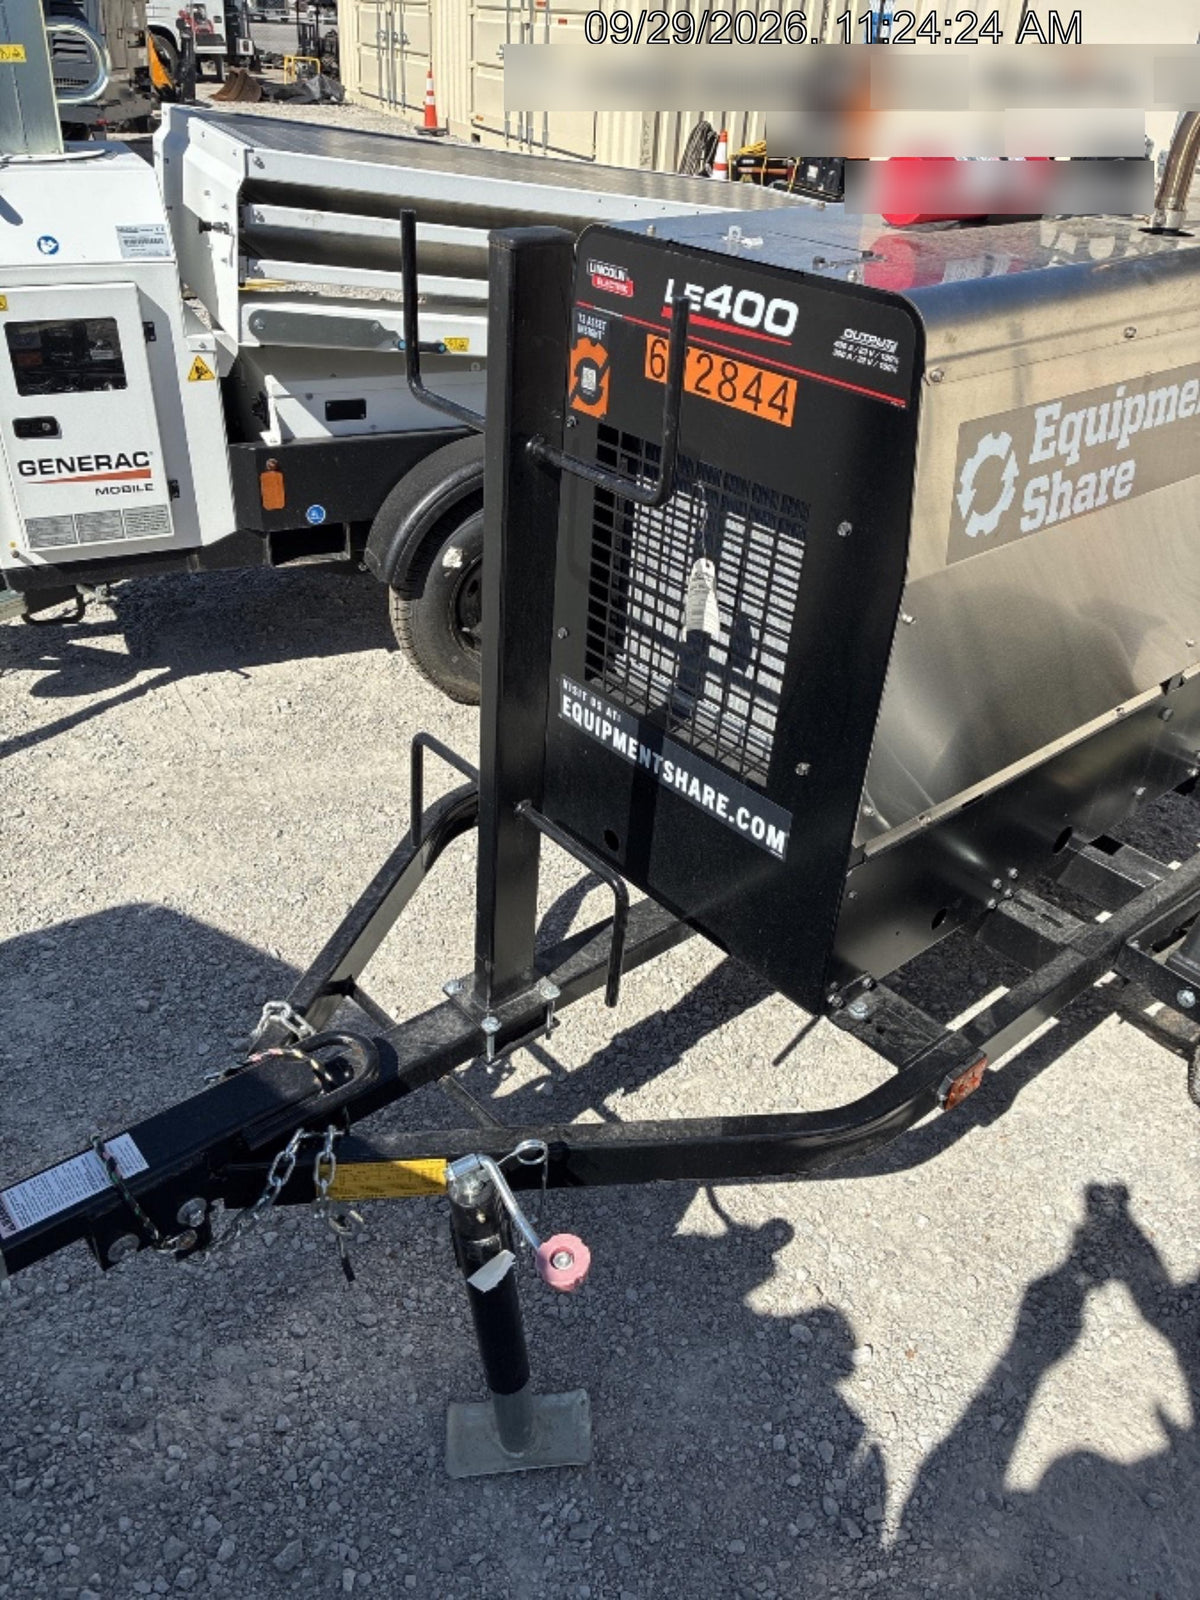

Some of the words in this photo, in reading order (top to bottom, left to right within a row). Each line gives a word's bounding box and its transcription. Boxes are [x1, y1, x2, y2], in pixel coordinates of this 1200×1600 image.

[589, 261, 626, 281] LINCOLN
[650, 339, 790, 421] 62844
[1028, 379, 1200, 466] Equipme
[17, 451, 150, 477] GENERAC
[95, 483, 154, 496] MOBILE
[1019, 459, 1136, 533] Share
[562, 694, 784, 855] EQUIPMENTSHARE.COM
